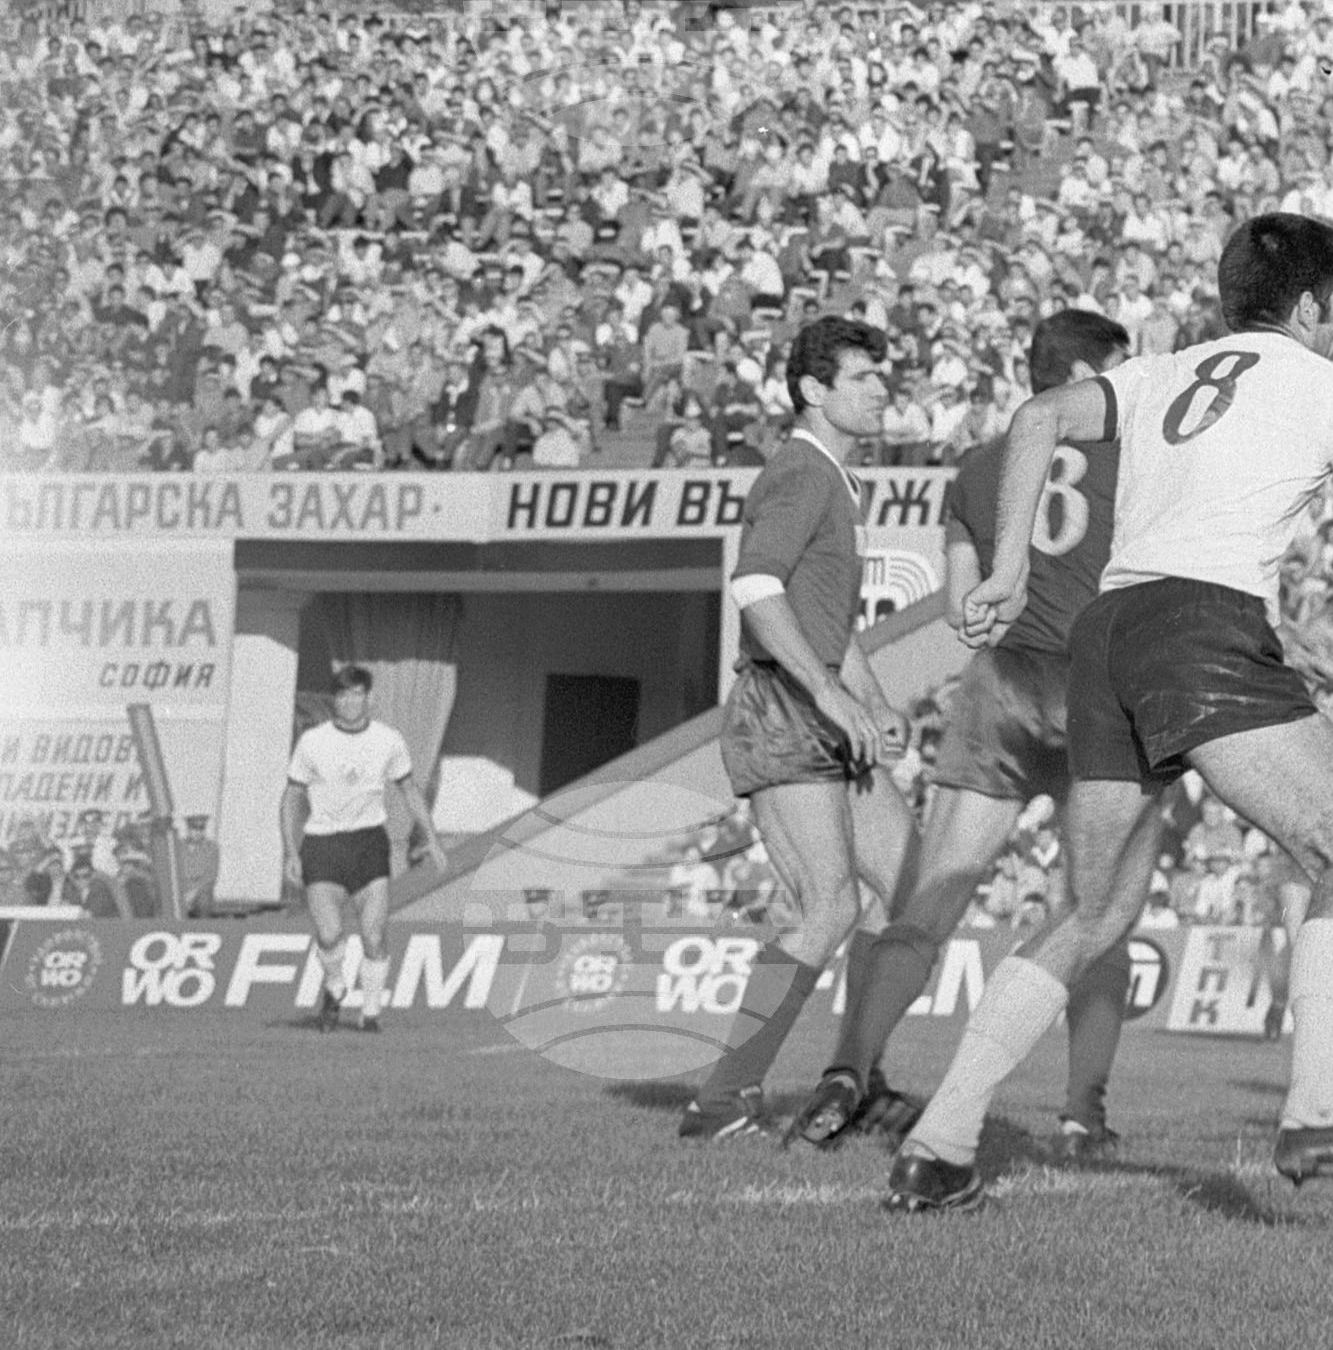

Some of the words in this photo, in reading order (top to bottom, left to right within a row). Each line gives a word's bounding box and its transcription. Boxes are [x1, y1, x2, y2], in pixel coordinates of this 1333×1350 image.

[1162, 350, 1261, 446] 8
[506, 480, 658, 529] НОВИ
[98, 661, 217, 691] СОФИЯ
[30, 733, 136, 764] ВИДОВ
